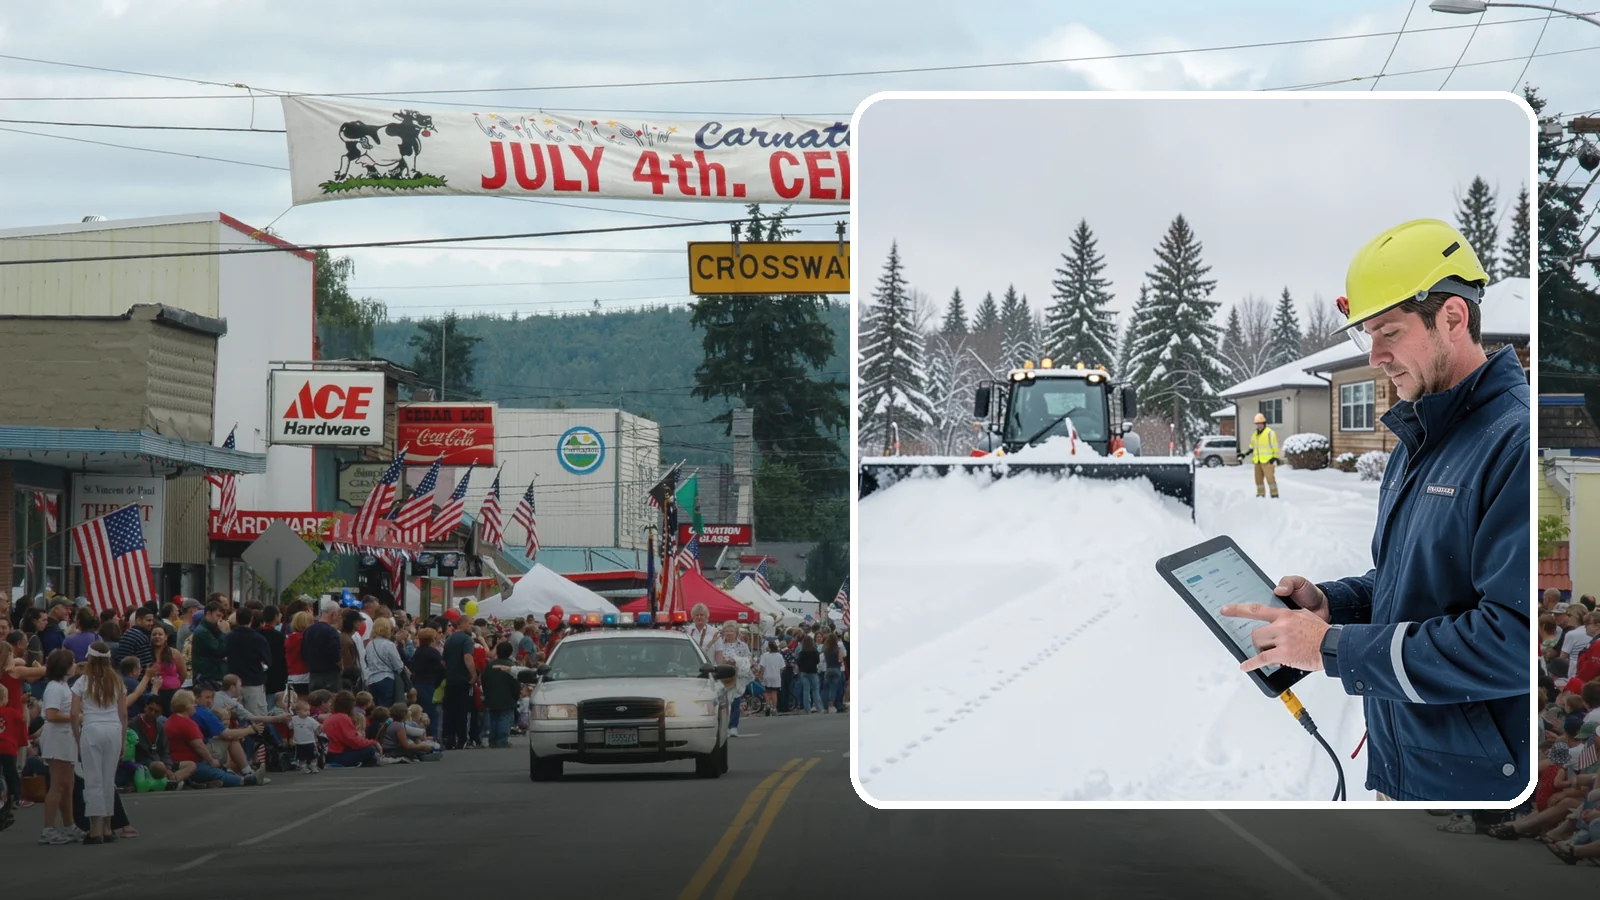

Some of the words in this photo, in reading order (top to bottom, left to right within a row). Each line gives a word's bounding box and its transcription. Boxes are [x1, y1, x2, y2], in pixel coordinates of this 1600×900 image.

[481, 141, 605, 192] JULY
[632, 150, 746, 197] 4th.
[697, 254, 850, 279] CROSSWA
[283, 380, 373, 419] ACE
[405, 409, 452, 421] CEDAR
[462, 409, 485, 421] LOG
[284, 421, 370, 436] Hardware
[416, 428, 476, 447] Coca-Cola
[83, 484, 94, 494] St.
[96, 485, 124, 495] Vincent
[126, 485, 136, 495] de
[138, 486, 155, 495] Paul
[688, 526, 741, 535] CRNATION
[699, 535, 730, 543] GLASS
